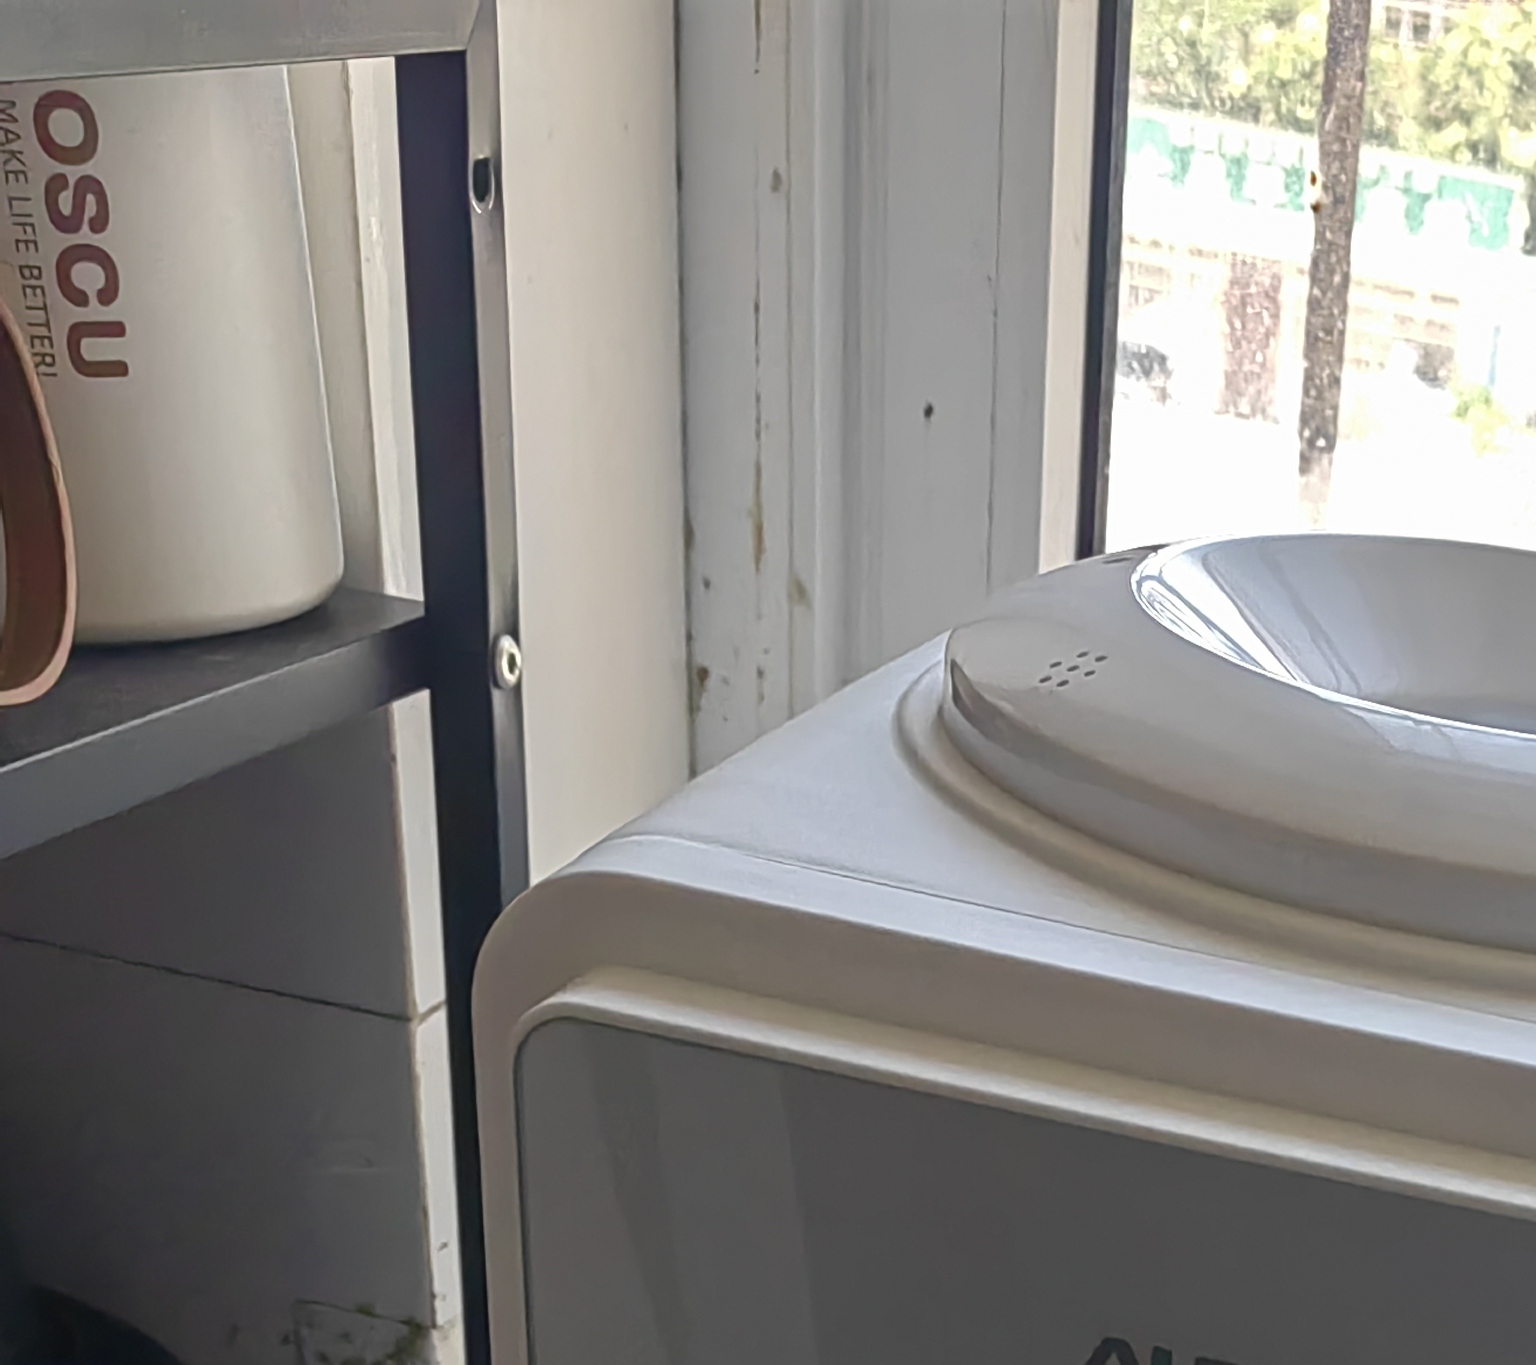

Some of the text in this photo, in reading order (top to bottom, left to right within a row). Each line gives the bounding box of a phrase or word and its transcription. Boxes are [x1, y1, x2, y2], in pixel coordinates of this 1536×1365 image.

[0, 100, 58, 377] MAKE LIFE BETTER!
[33, 89, 129, 378] OSCU
